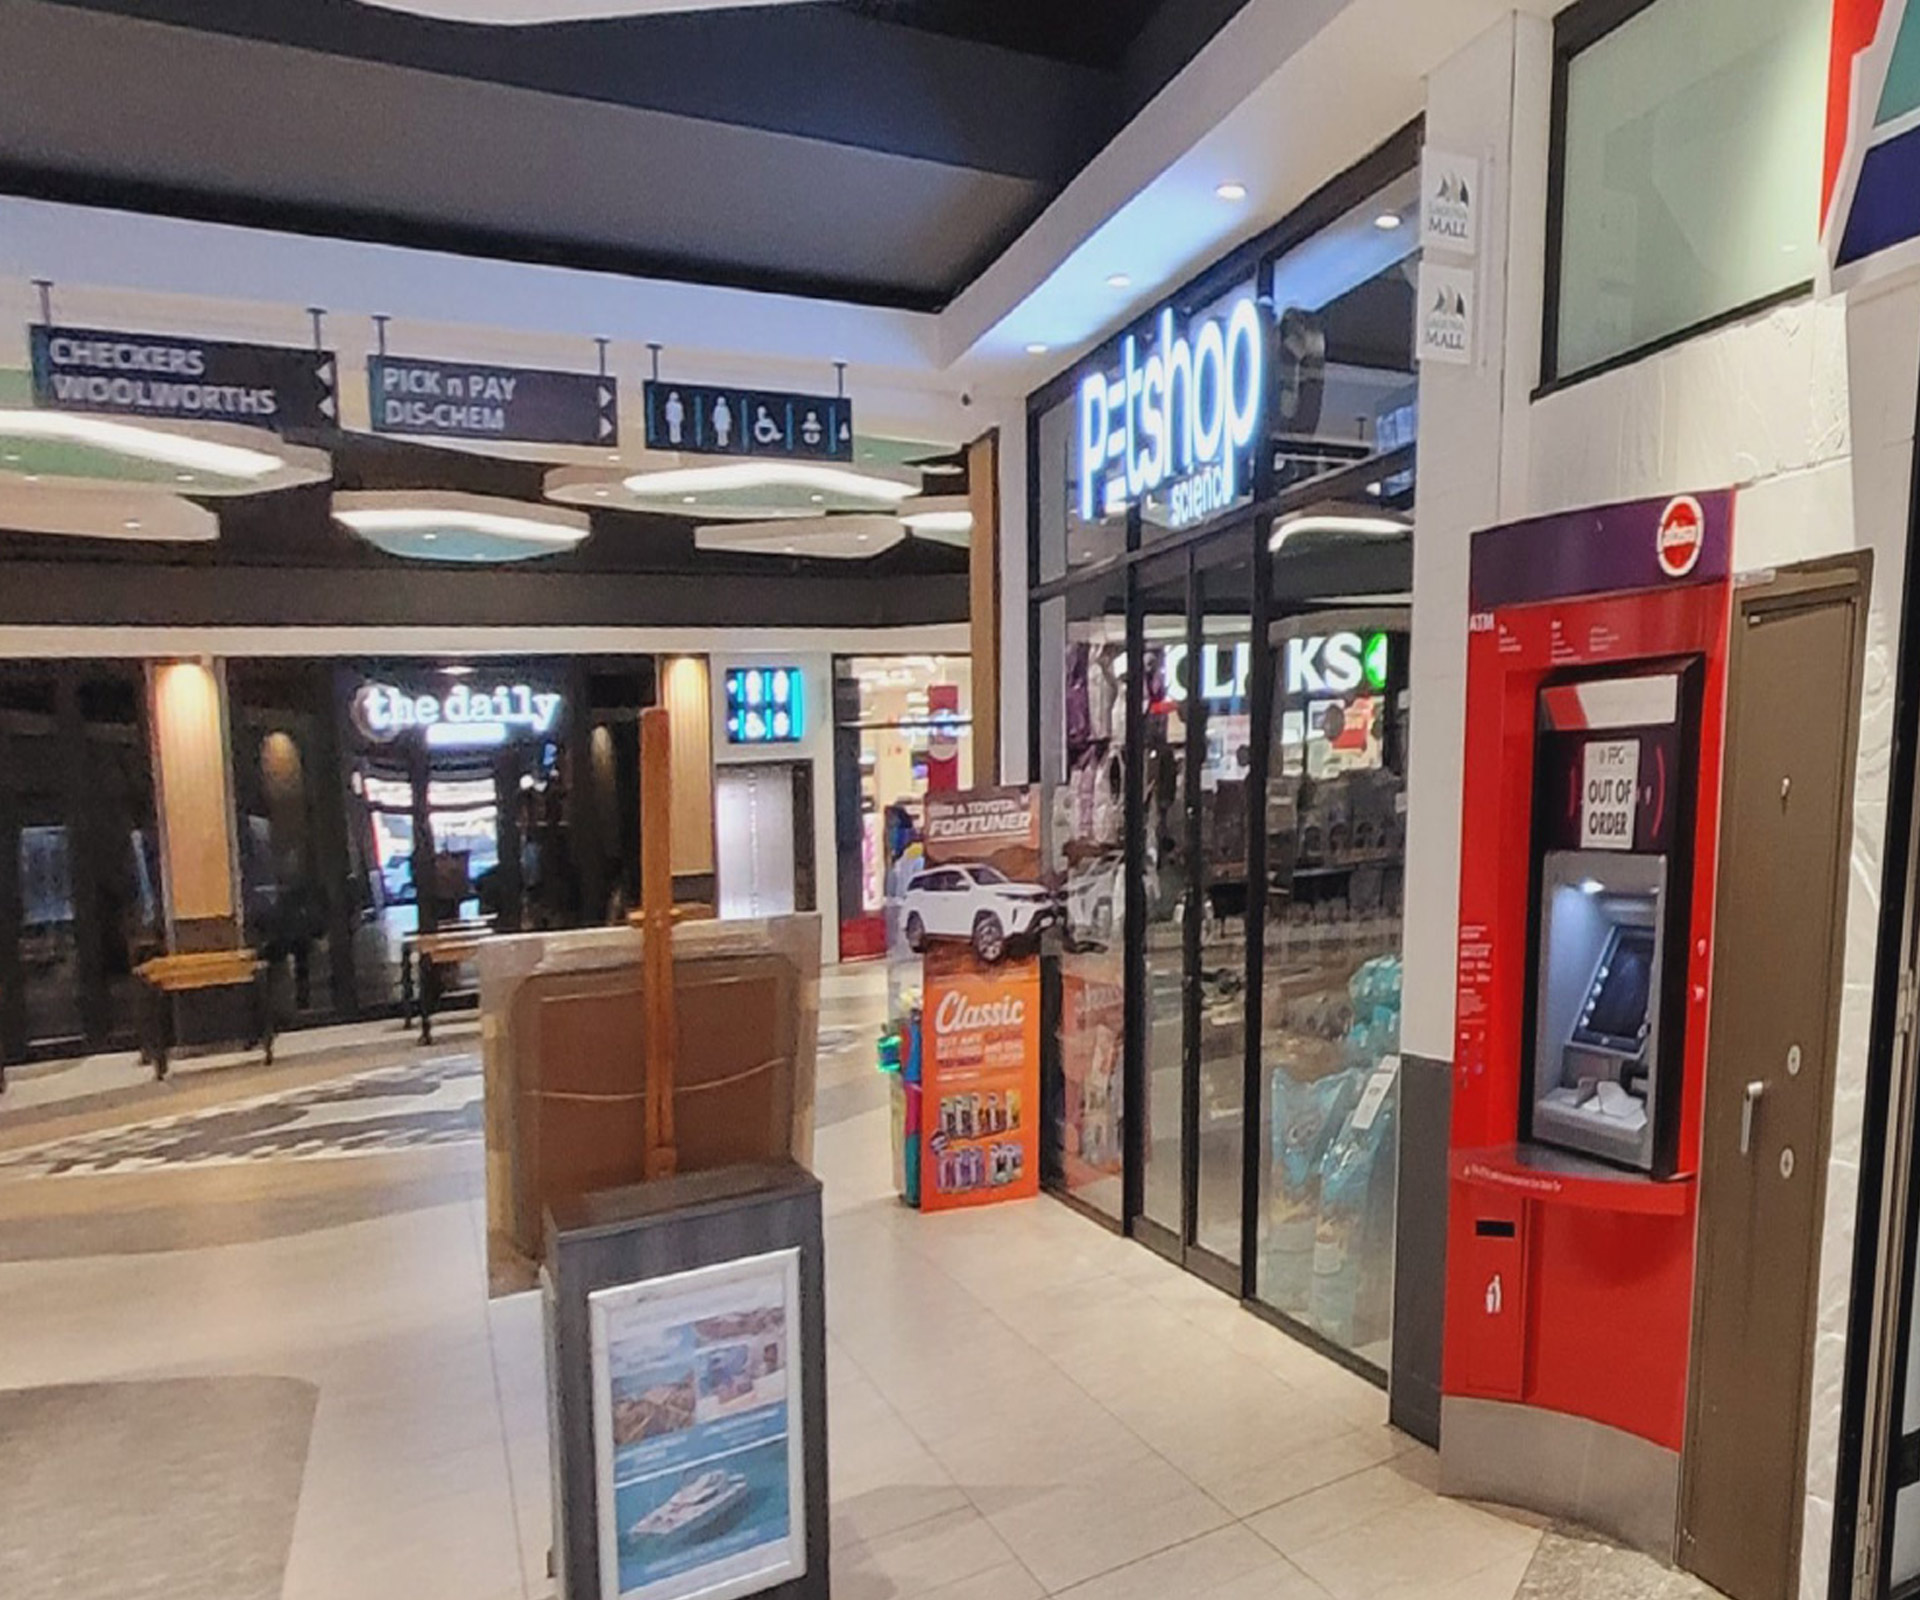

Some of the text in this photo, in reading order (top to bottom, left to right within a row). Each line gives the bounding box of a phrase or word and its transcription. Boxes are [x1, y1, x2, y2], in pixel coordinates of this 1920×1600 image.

[1427, 215, 1470, 240] MALL
[49, 337, 205, 376] CHECKERS
[1424, 328, 1466, 351] MALL
[50, 374, 276, 415] WOOLWORTHS
[382, 366, 517, 401] PICK n PAY
[385, 398, 506, 431] DIS-CHEM
[1171, 464, 1225, 528] scienc
[1164, 631, 1363, 702] CLIKS
[362, 683, 562, 732] the daily
[1588, 778, 1632, 803] OUT OF
[928, 811, 1032, 837] FORTUNER
[1588, 811, 1628, 836] ORDER
[935, 990, 1026, 1035] Classic
